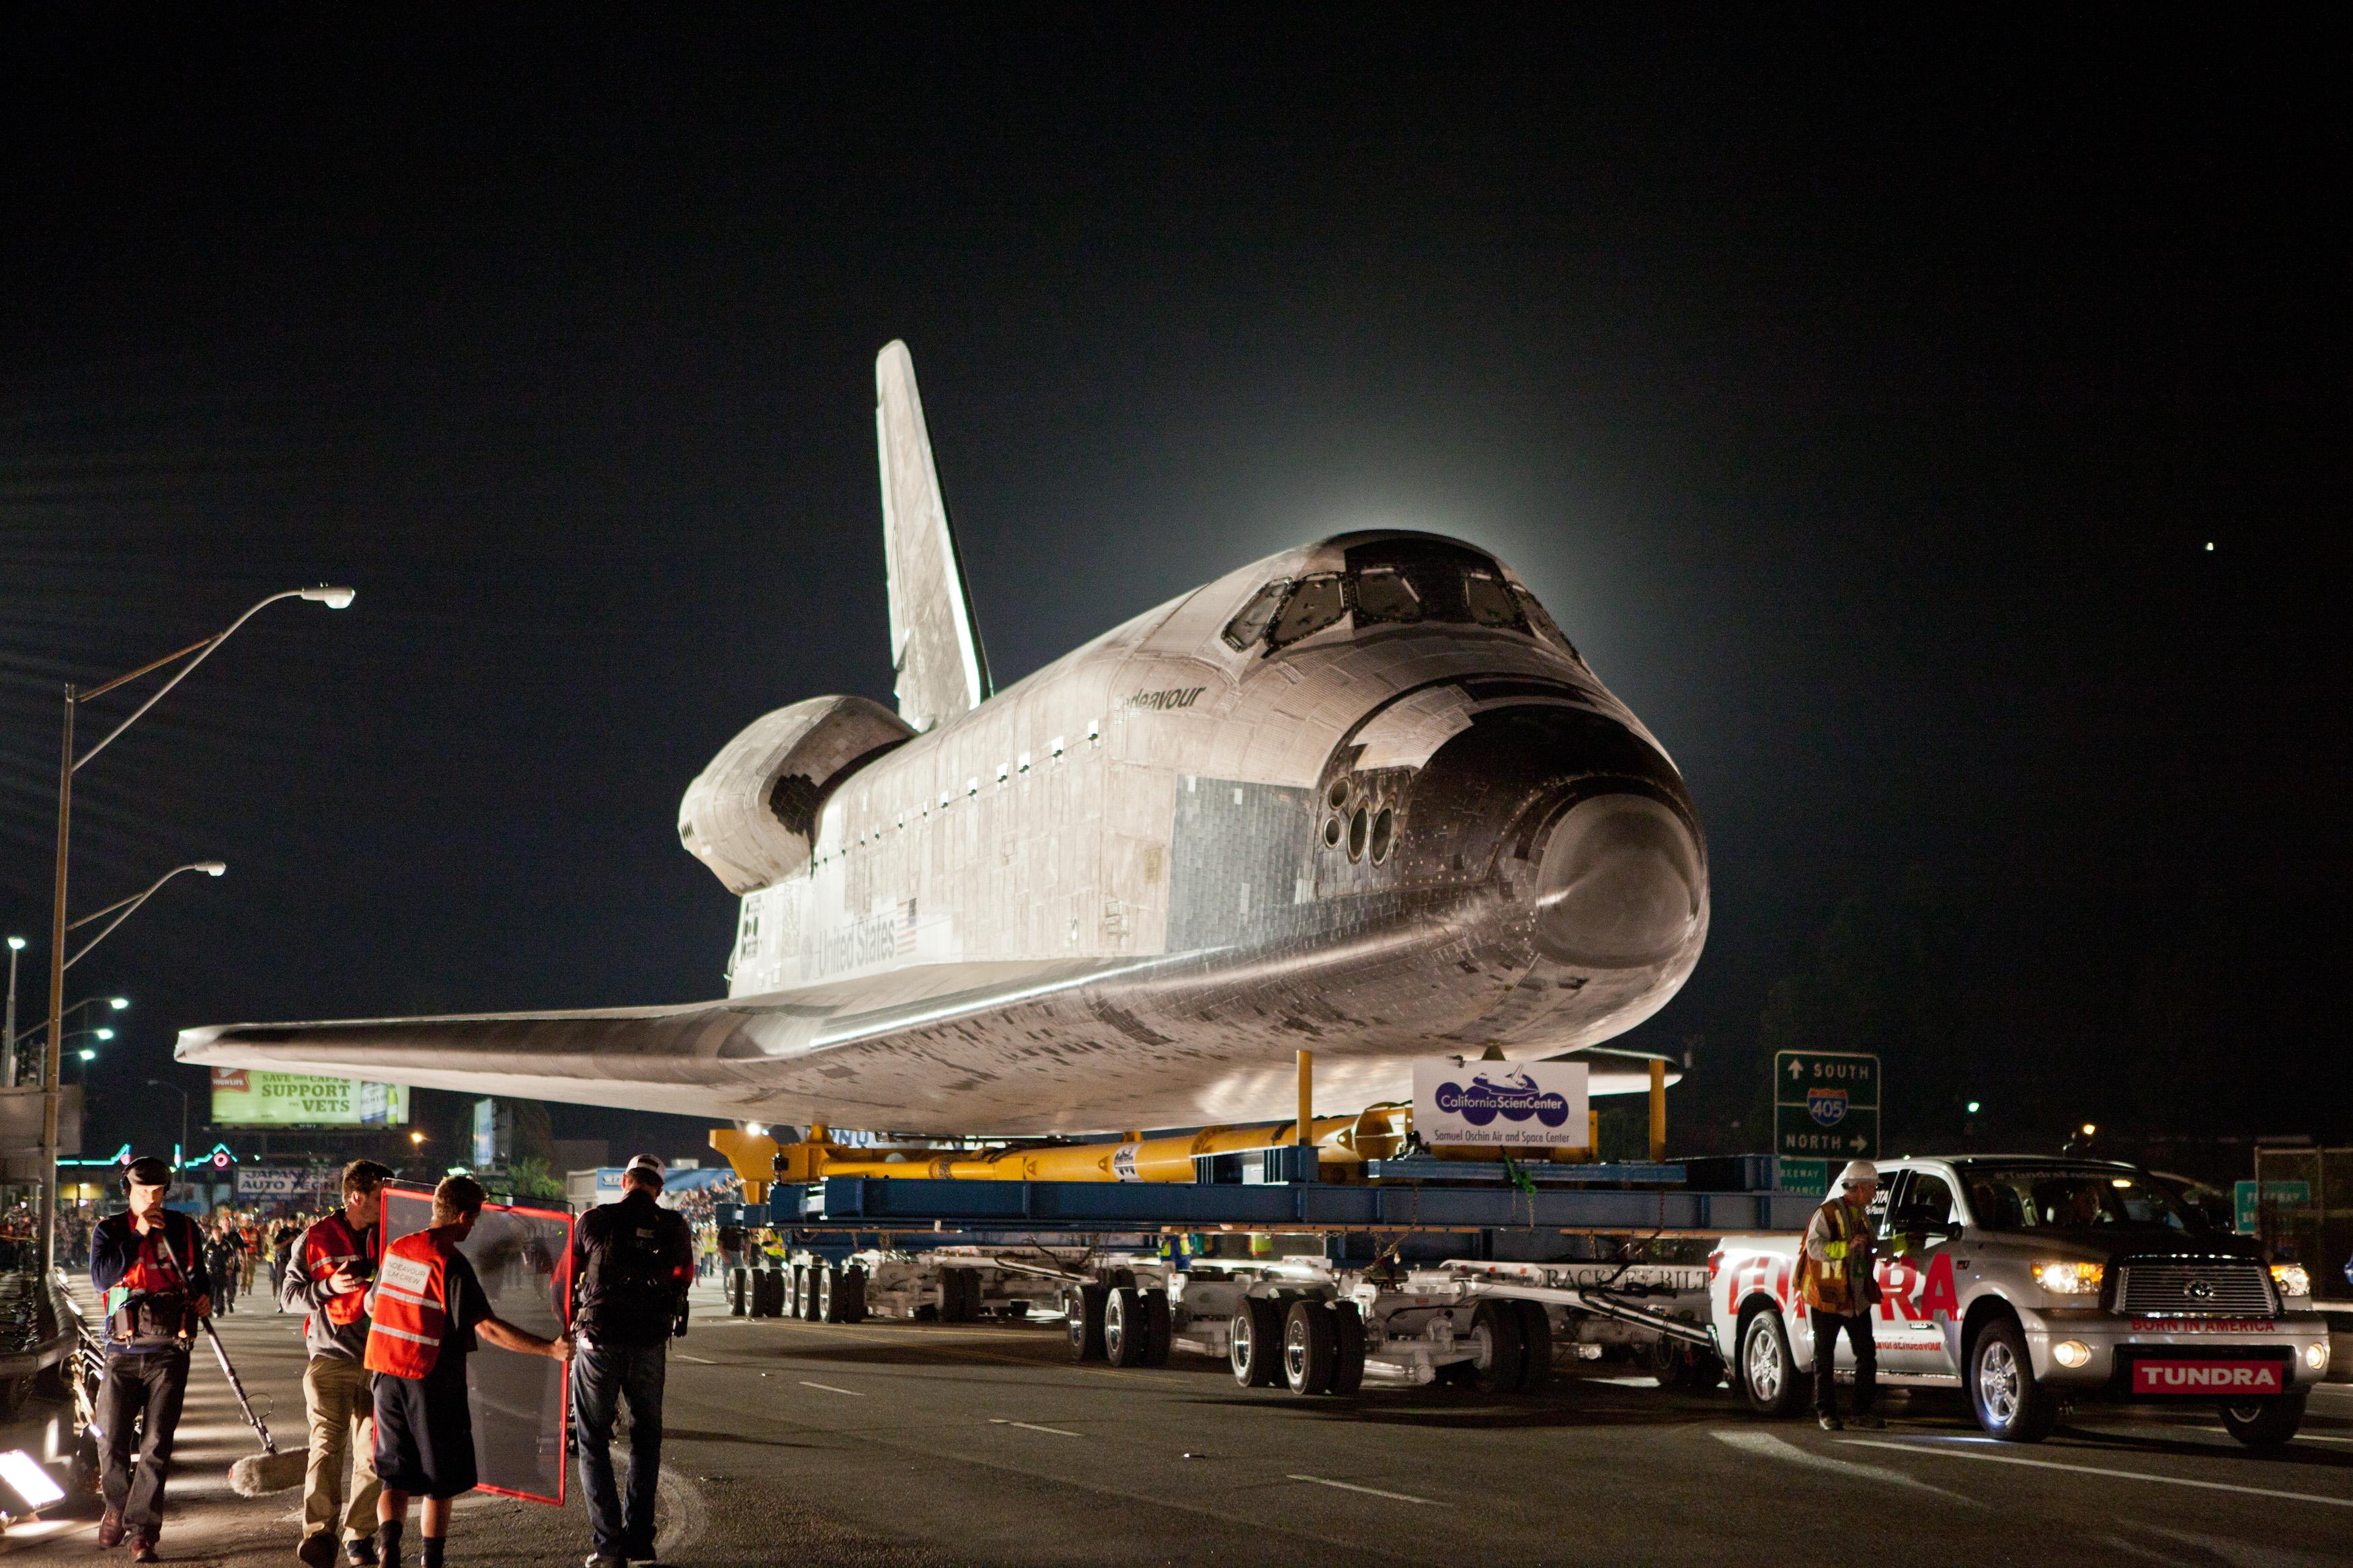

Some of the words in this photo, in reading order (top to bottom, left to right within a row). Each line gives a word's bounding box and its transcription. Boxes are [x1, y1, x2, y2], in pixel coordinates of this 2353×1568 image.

[819, 924, 854, 977] United
[856, 915, 895, 968] States
[262, 1074, 290, 1083] SAVE
[1813, 1063, 1870, 1080] SOUTH
[262, 1084, 350, 1098] SUPPORT
[301, 1100, 350, 1112] VETS
[1811, 1100, 1845, 1118] 405
[1434, 1130, 1463, 1141] Samuel
[1465, 1130, 1490, 1142] Oschin
[1492, 1131, 1503, 1142] Air
[1505, 1130, 1519, 1142] and
[1521, 1131, 1544, 1144] Space
[1546, 1131, 1570, 1143] Center
[1785, 1134, 1841, 1150] NORTH
[241, 1180, 285, 1190] AUTO
[291, 1181, 335, 1190] TECH
[388, 1262, 426, 1276] NDEAVOUR
[399, 1274, 420, 1285] CREW
[1660, 1270, 1710, 1290] BILT
[2131, 1319, 2178, 1332] BORN
[2184, 1319, 2200, 1332] IN
[2204, 1319, 2275, 1332] AMERICA
[2141, 1366, 2276, 1386] TUNDRA
